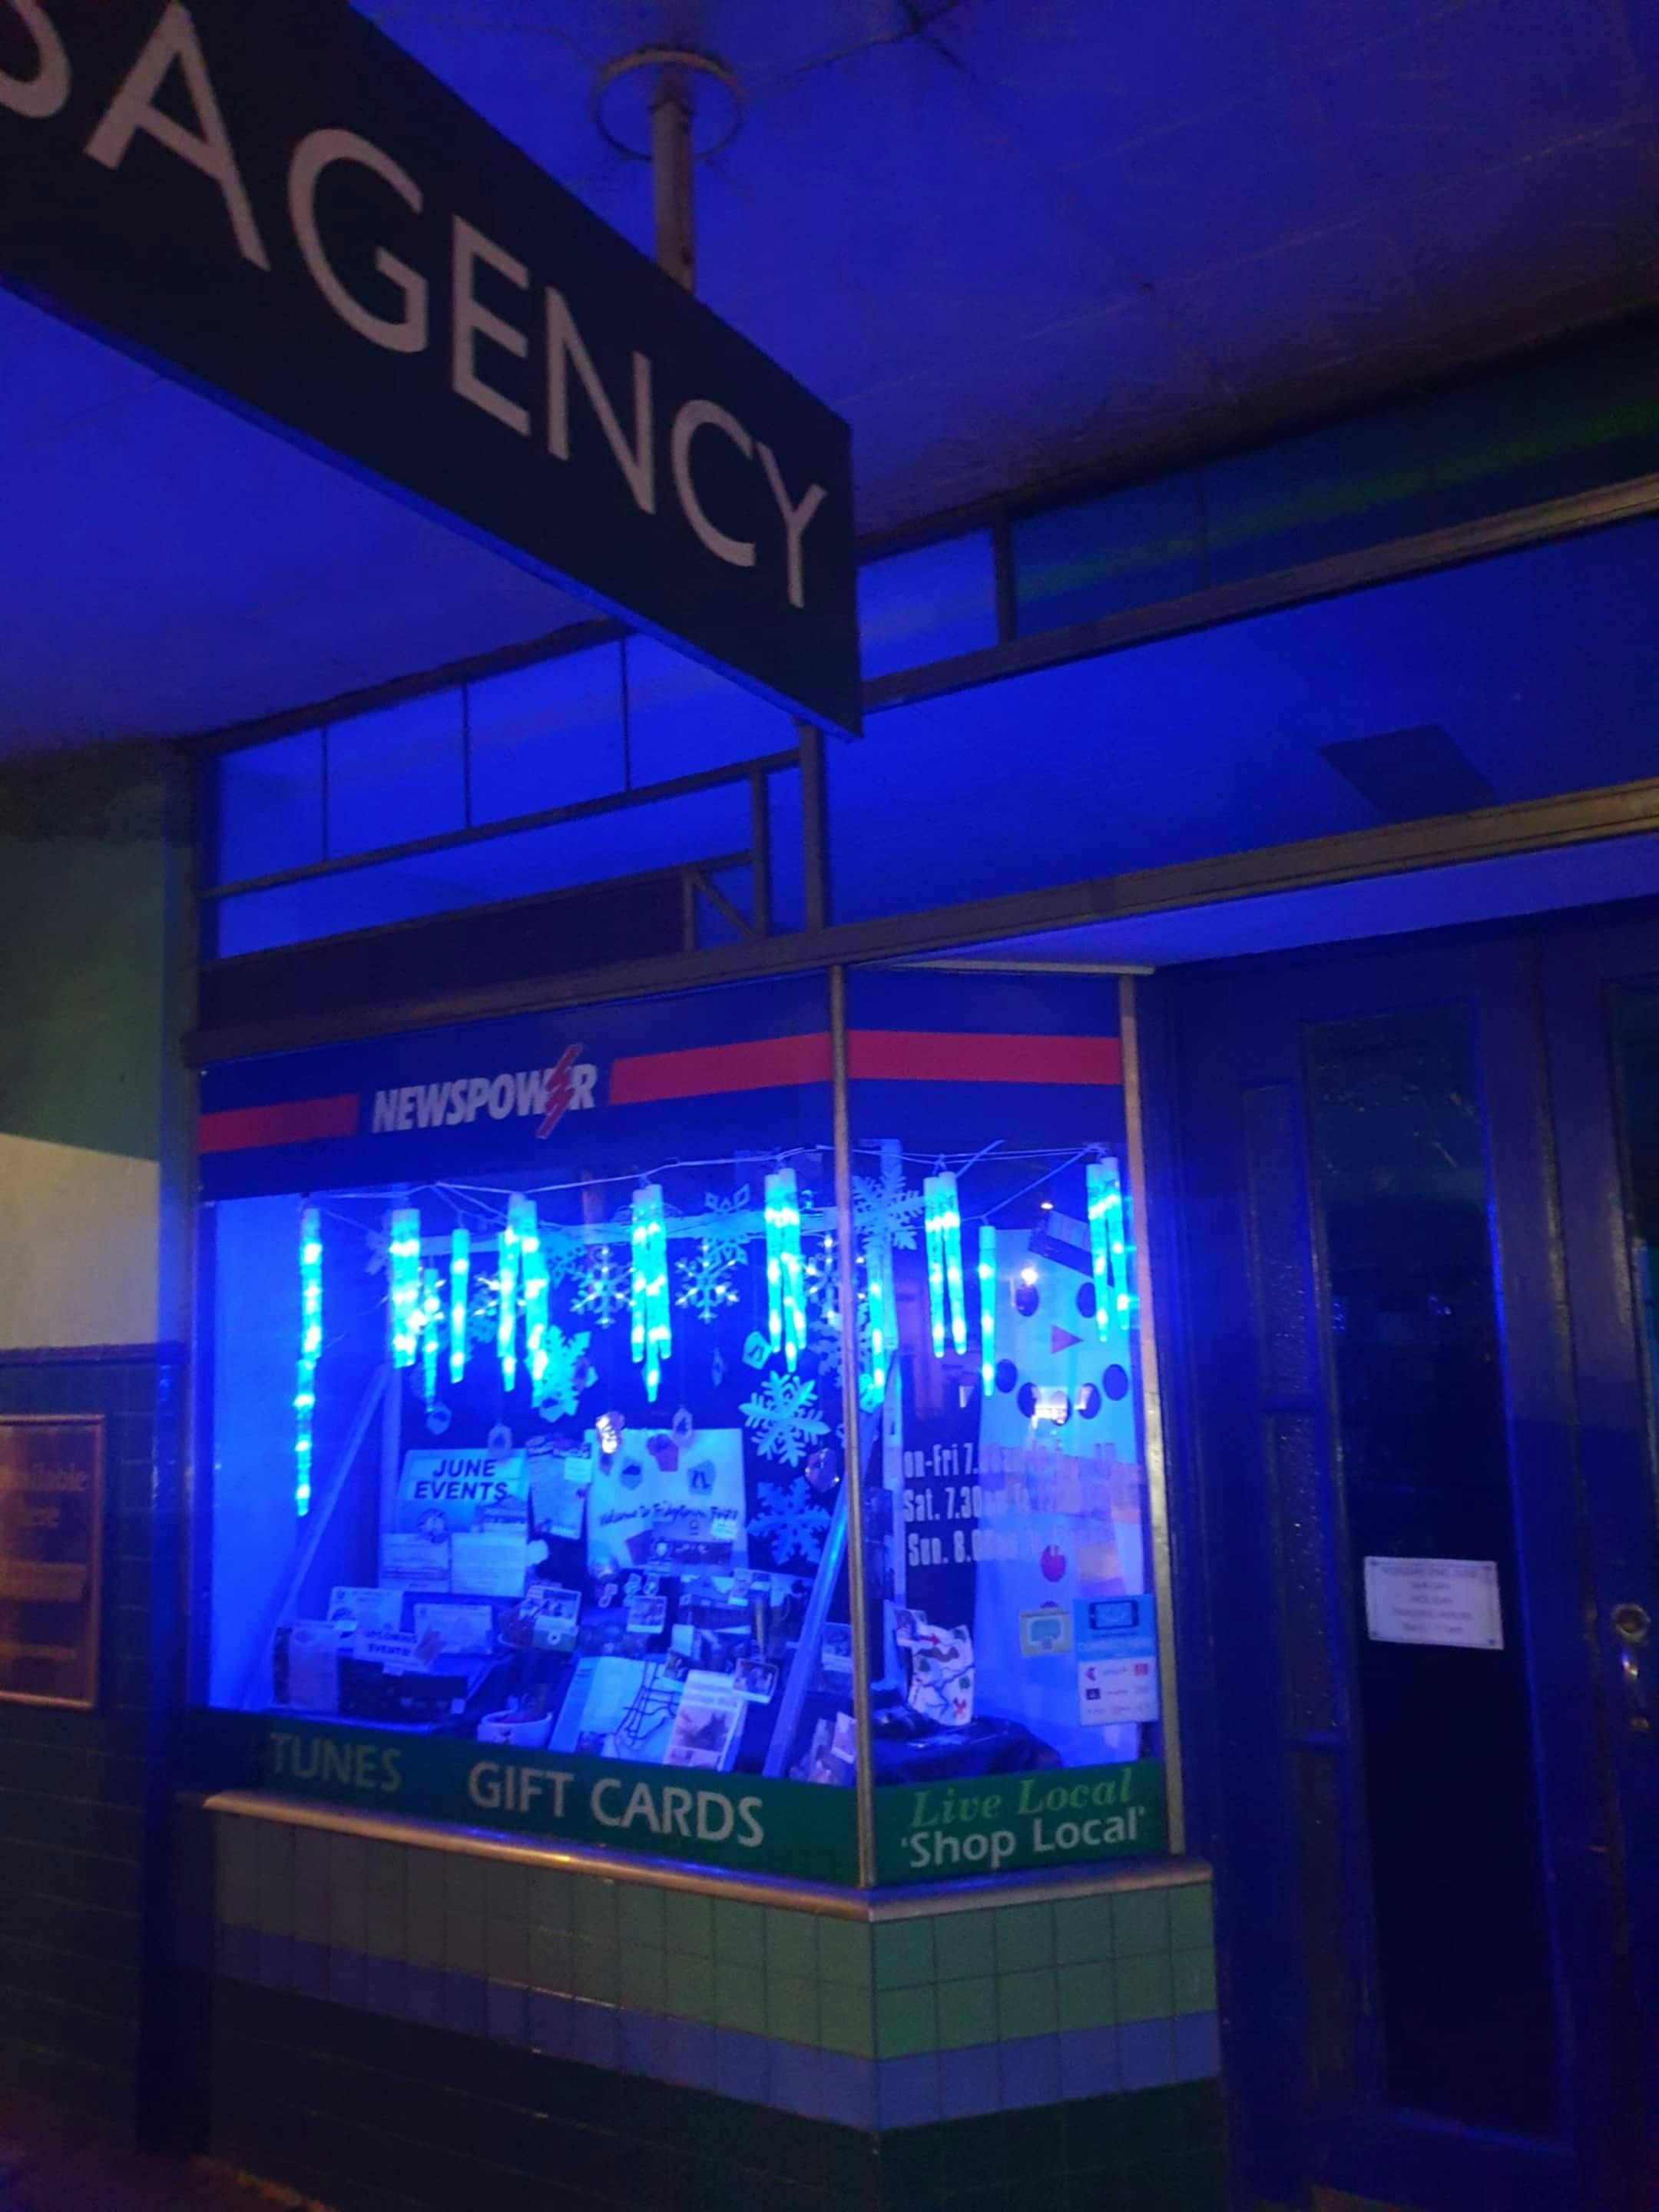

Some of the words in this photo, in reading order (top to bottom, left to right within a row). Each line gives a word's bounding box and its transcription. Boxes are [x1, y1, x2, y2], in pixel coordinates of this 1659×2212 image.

[433, 1459, 498, 1478] JUNE
[414, 1481, 508, 1501] EVENTS
[902, 1488, 941, 1522] Sat.
[908, 1532, 949, 1567] Sun.
[468, 1761, 573, 1821] GIFT
[590, 1778, 764, 1848] CARDS
[912, 1779, 1002, 1829] Live
[1018, 1767, 1135, 1816] Local
